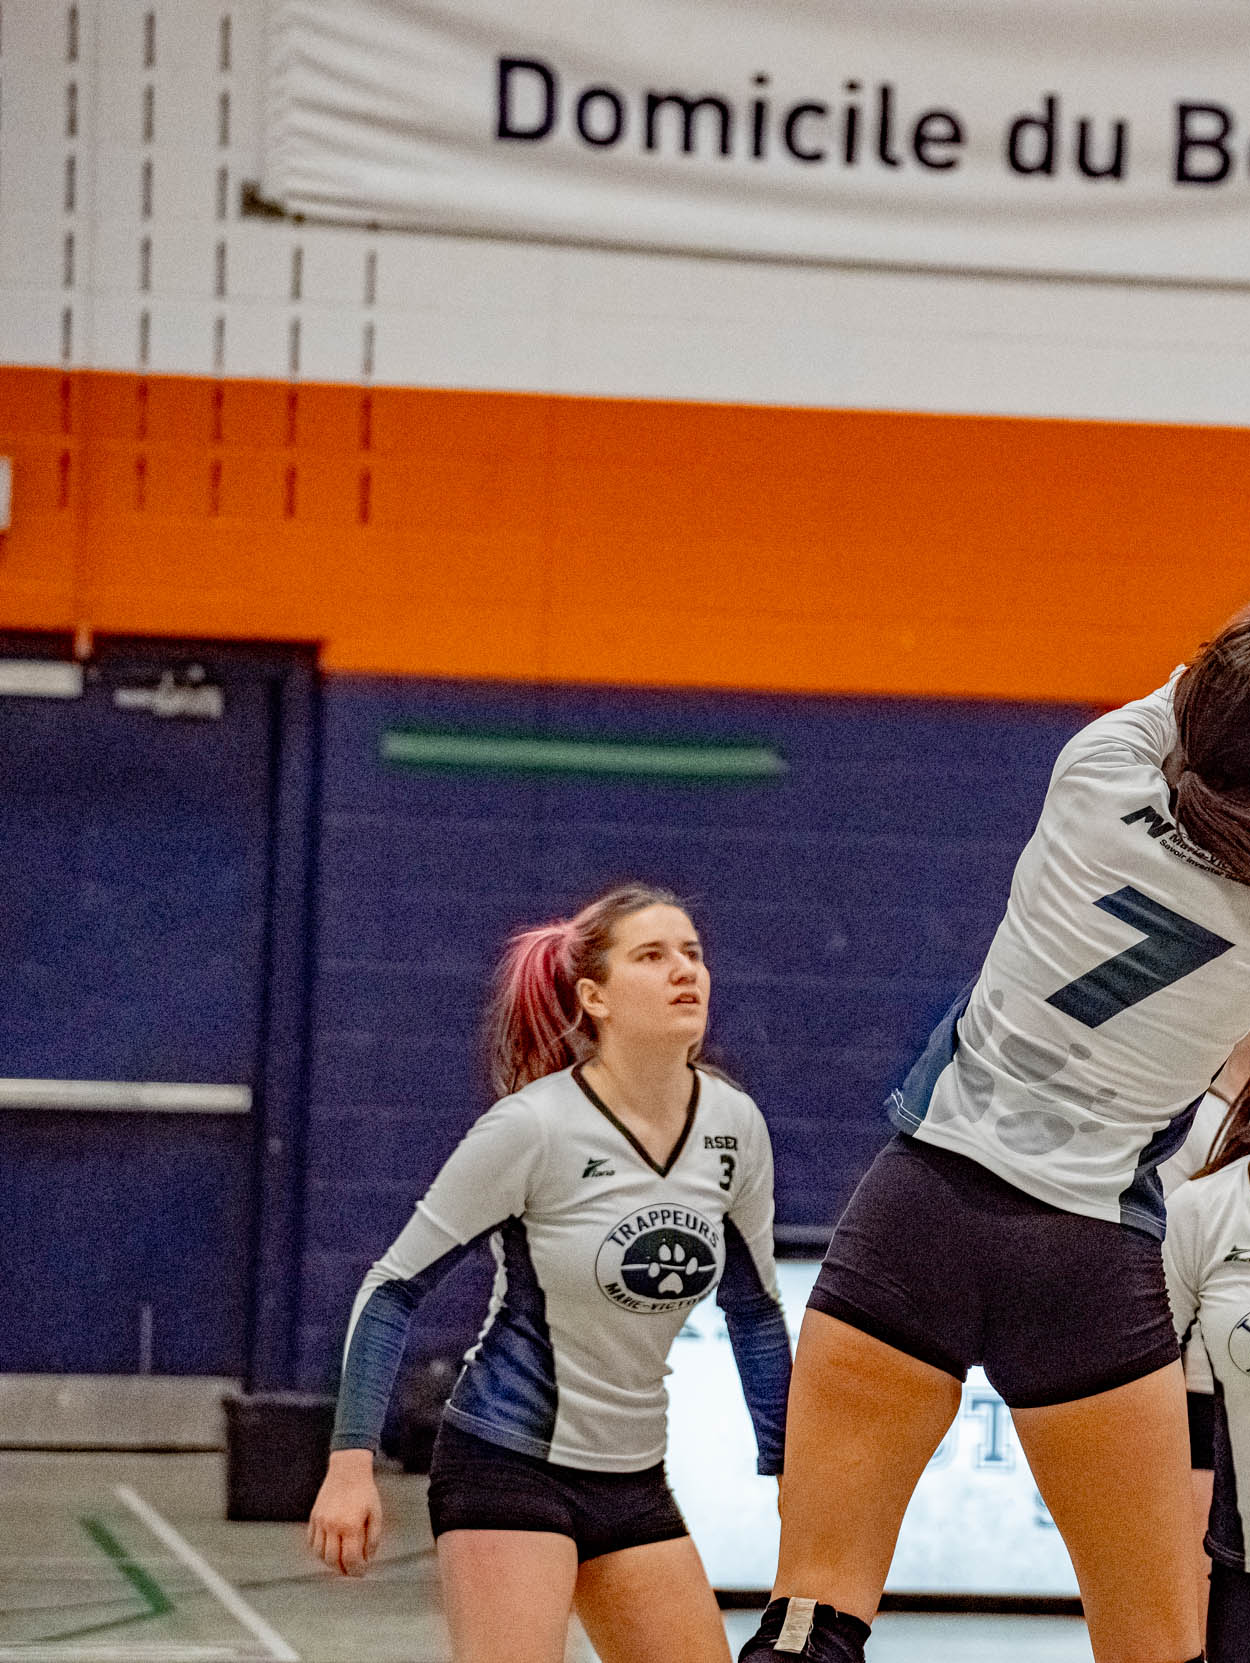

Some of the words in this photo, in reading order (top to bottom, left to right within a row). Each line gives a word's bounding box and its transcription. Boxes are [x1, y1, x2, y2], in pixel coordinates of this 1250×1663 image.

[497, 57, 966, 170] Domicile
[1007, 93, 1128, 180] du
[1044, 885, 1236, 1029] 7
[719, 1153, 735, 1191] 3
[607, 1208, 720, 1249] TRAPPEURS
